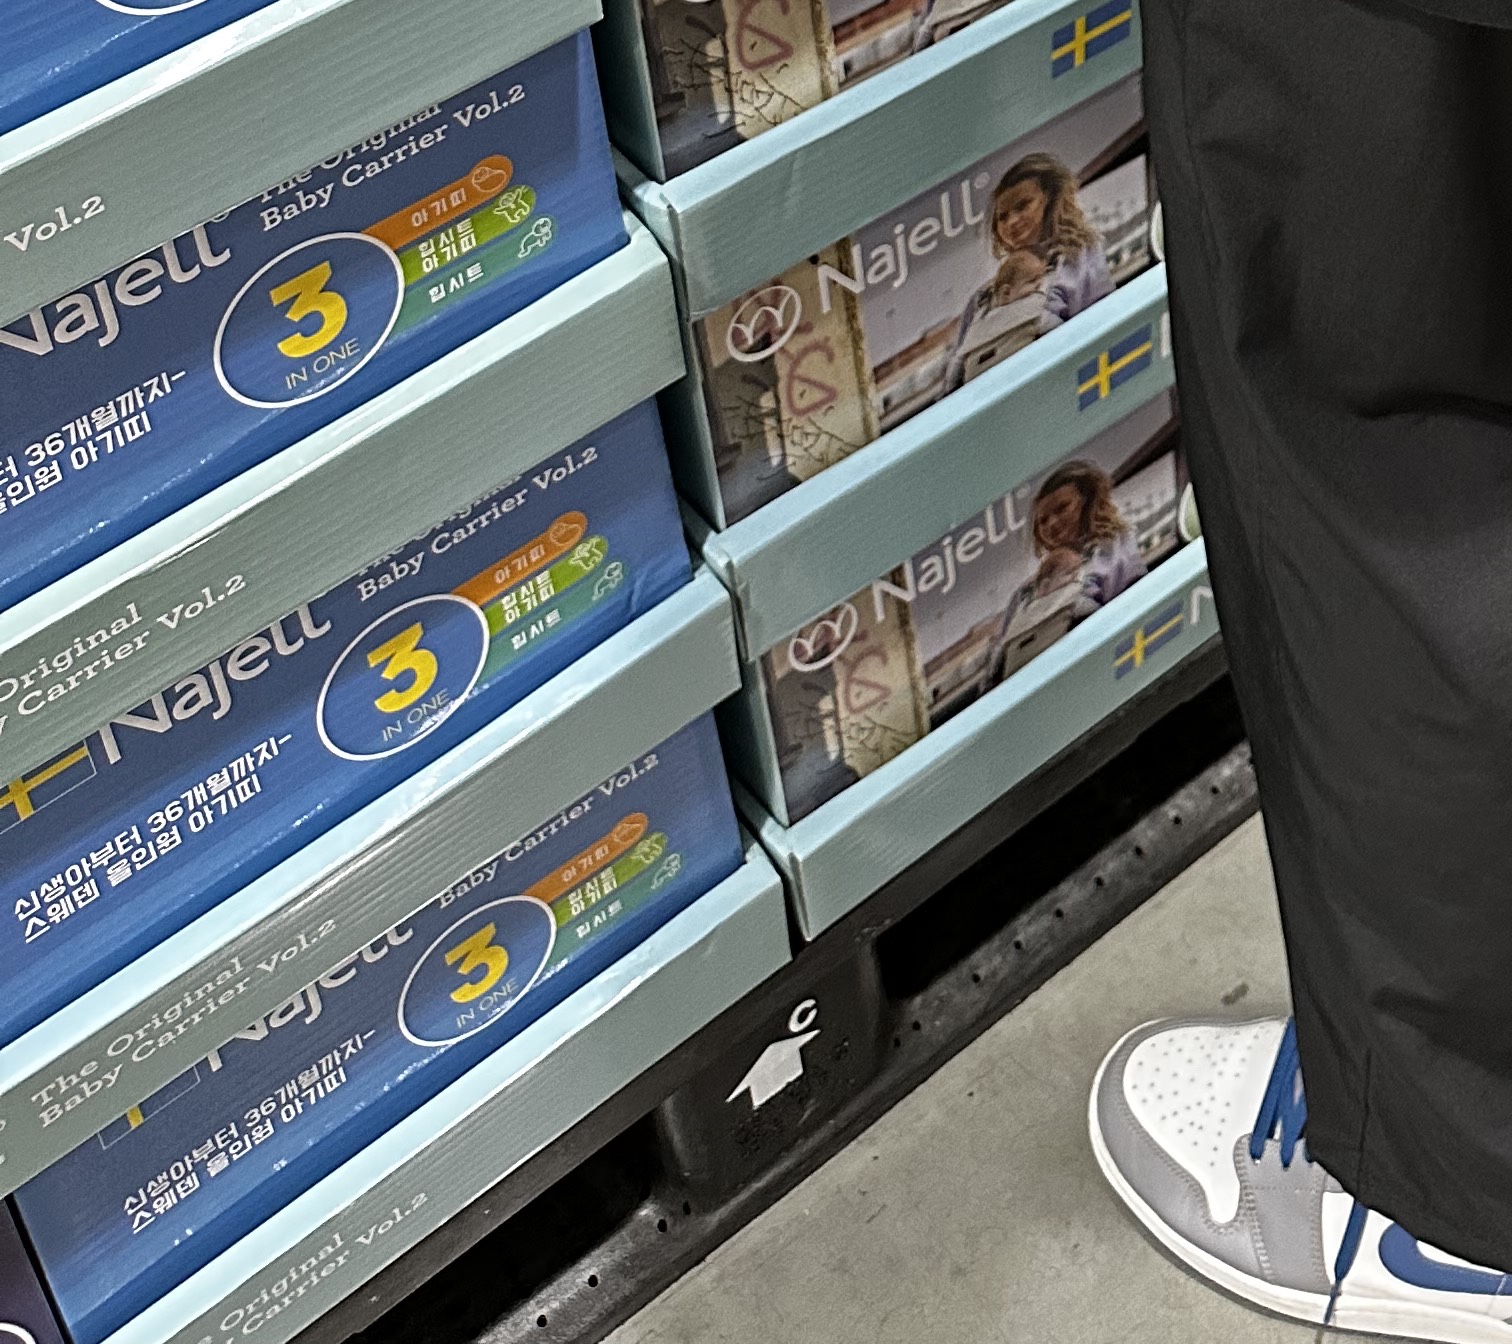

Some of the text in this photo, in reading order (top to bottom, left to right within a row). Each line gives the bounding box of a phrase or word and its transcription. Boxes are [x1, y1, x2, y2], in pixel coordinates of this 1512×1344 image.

[260, 83, 526, 232] Baby Carrier Vol.2
[3, 195, 105, 253] Vol.2
[269, 260, 349, 358] 3
[284, 337, 361, 391] IN ONE
[356, 550, 426, 602] Baby
[430, 487, 529, 554] Carrier
[532, 445, 598, 490] Vol.2
[17, 573, 248, 716] Carrier Vol.2
[366, 621, 439, 713] 3
[381, 687, 451, 743] IN ONE
[438, 752, 660, 910] Baby Carrier Vol.2
[444, 921, 510, 1004] 3
[455, 976, 520, 1028] IN ONE
[30, 1058, 99, 1107] The
[107, 956, 246, 1058] Original
[39, 1063, 125, 1128] Baby
[131, 976, 254, 1064] Carrier
[257, 918, 337, 973] Vol.2
[787, 998, 818, 1032] C
[219, 1231, 345, 1332] Original
[241, 1191, 429, 1336] Carrier Vol.2
